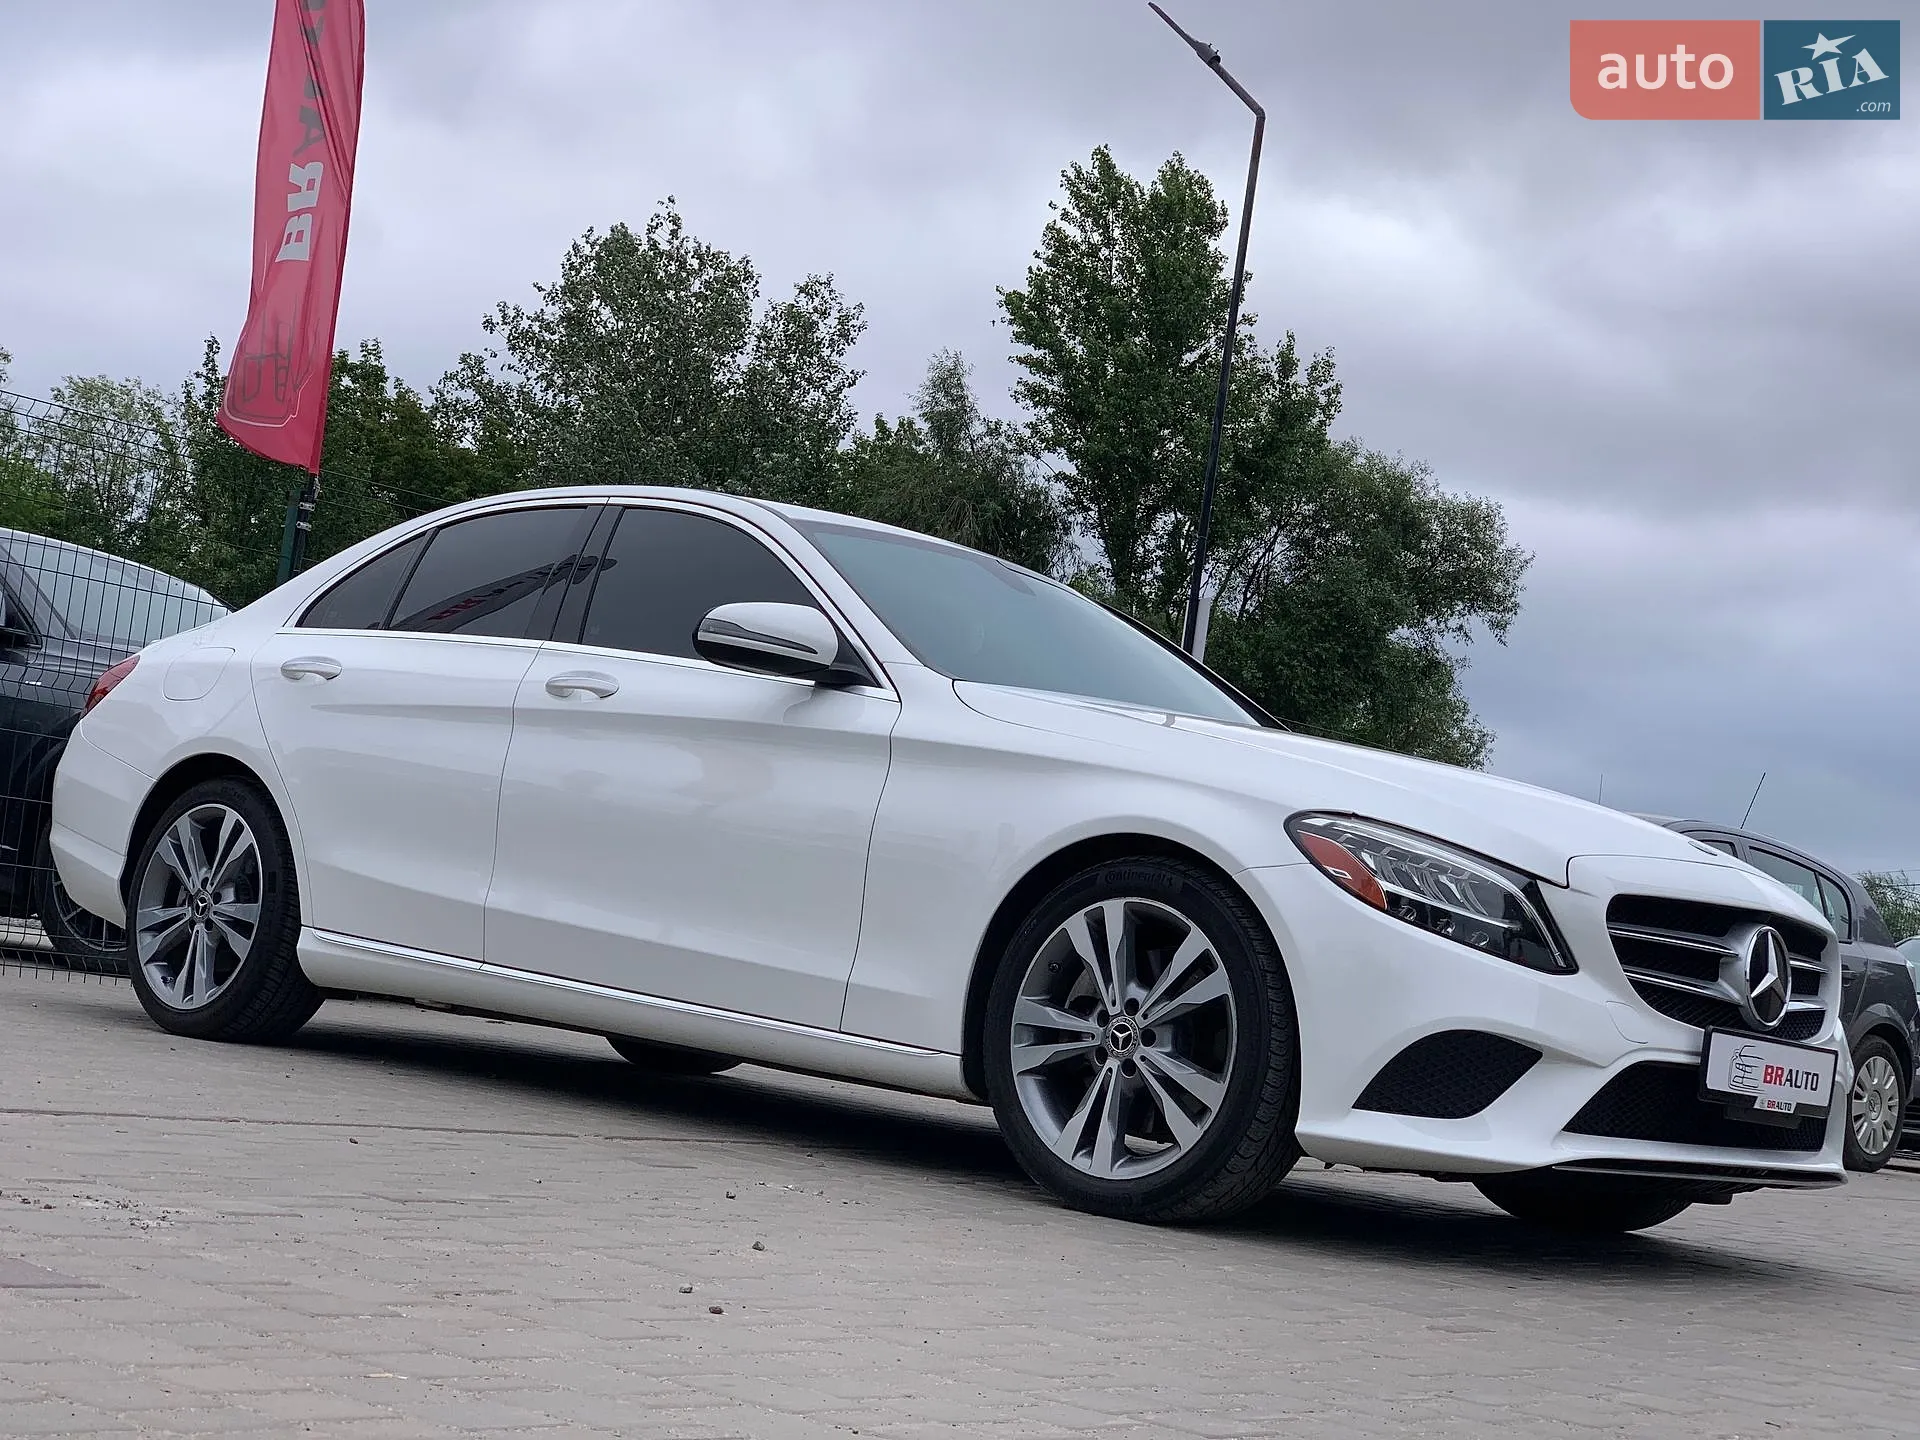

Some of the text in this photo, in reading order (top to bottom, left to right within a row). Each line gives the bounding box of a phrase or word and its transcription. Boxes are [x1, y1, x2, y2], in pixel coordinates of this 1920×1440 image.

[1105, 868, 1168, 885] Continental
[1763, 1064, 1819, 1092] BRAUTO
[1767, 1099, 1792, 1112] BRAUTO
